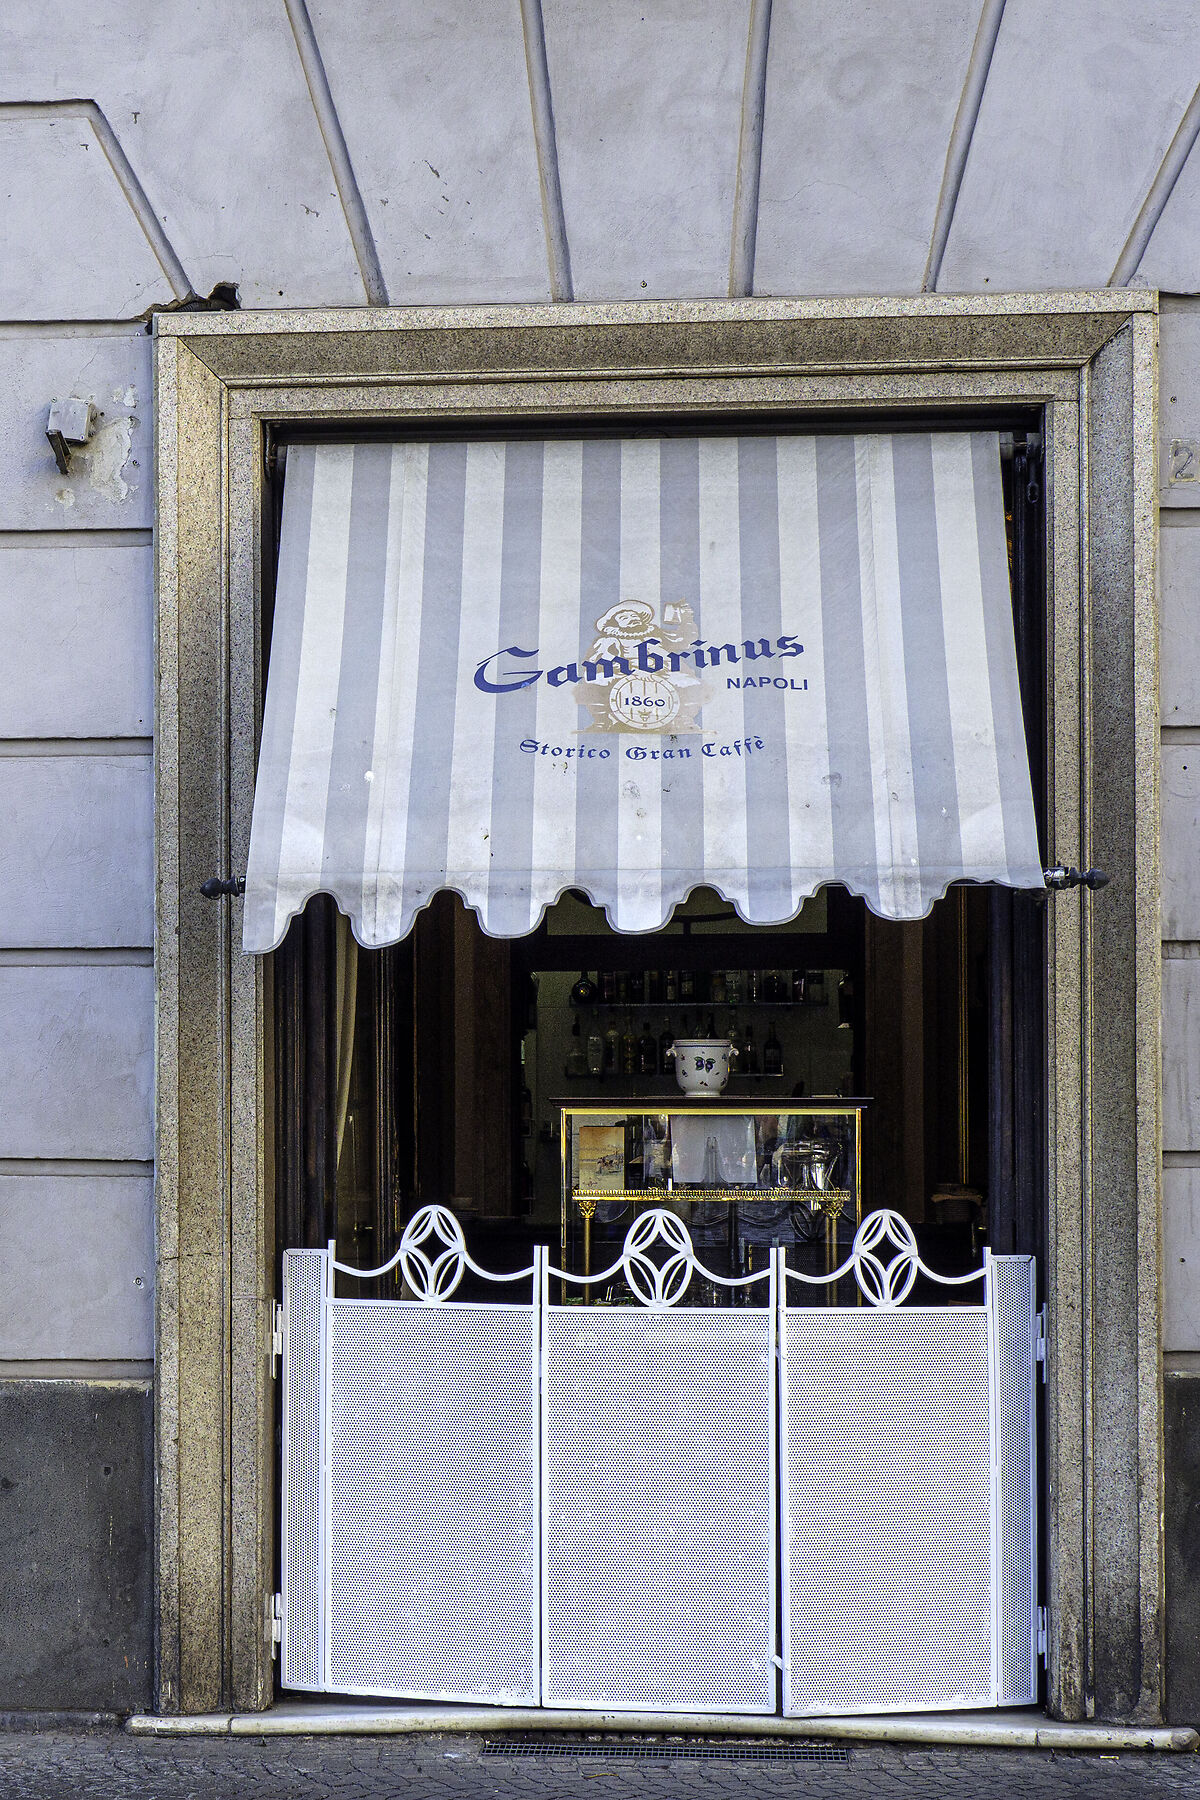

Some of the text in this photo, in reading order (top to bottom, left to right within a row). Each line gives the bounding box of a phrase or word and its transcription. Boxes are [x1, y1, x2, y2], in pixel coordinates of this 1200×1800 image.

[473, 634, 807, 694] Gambrinus
[726, 676, 809, 691] NAPOLI
[624, 695, 666, 708] 1860
[518, 735, 767, 761] Storico Gran Caffè
